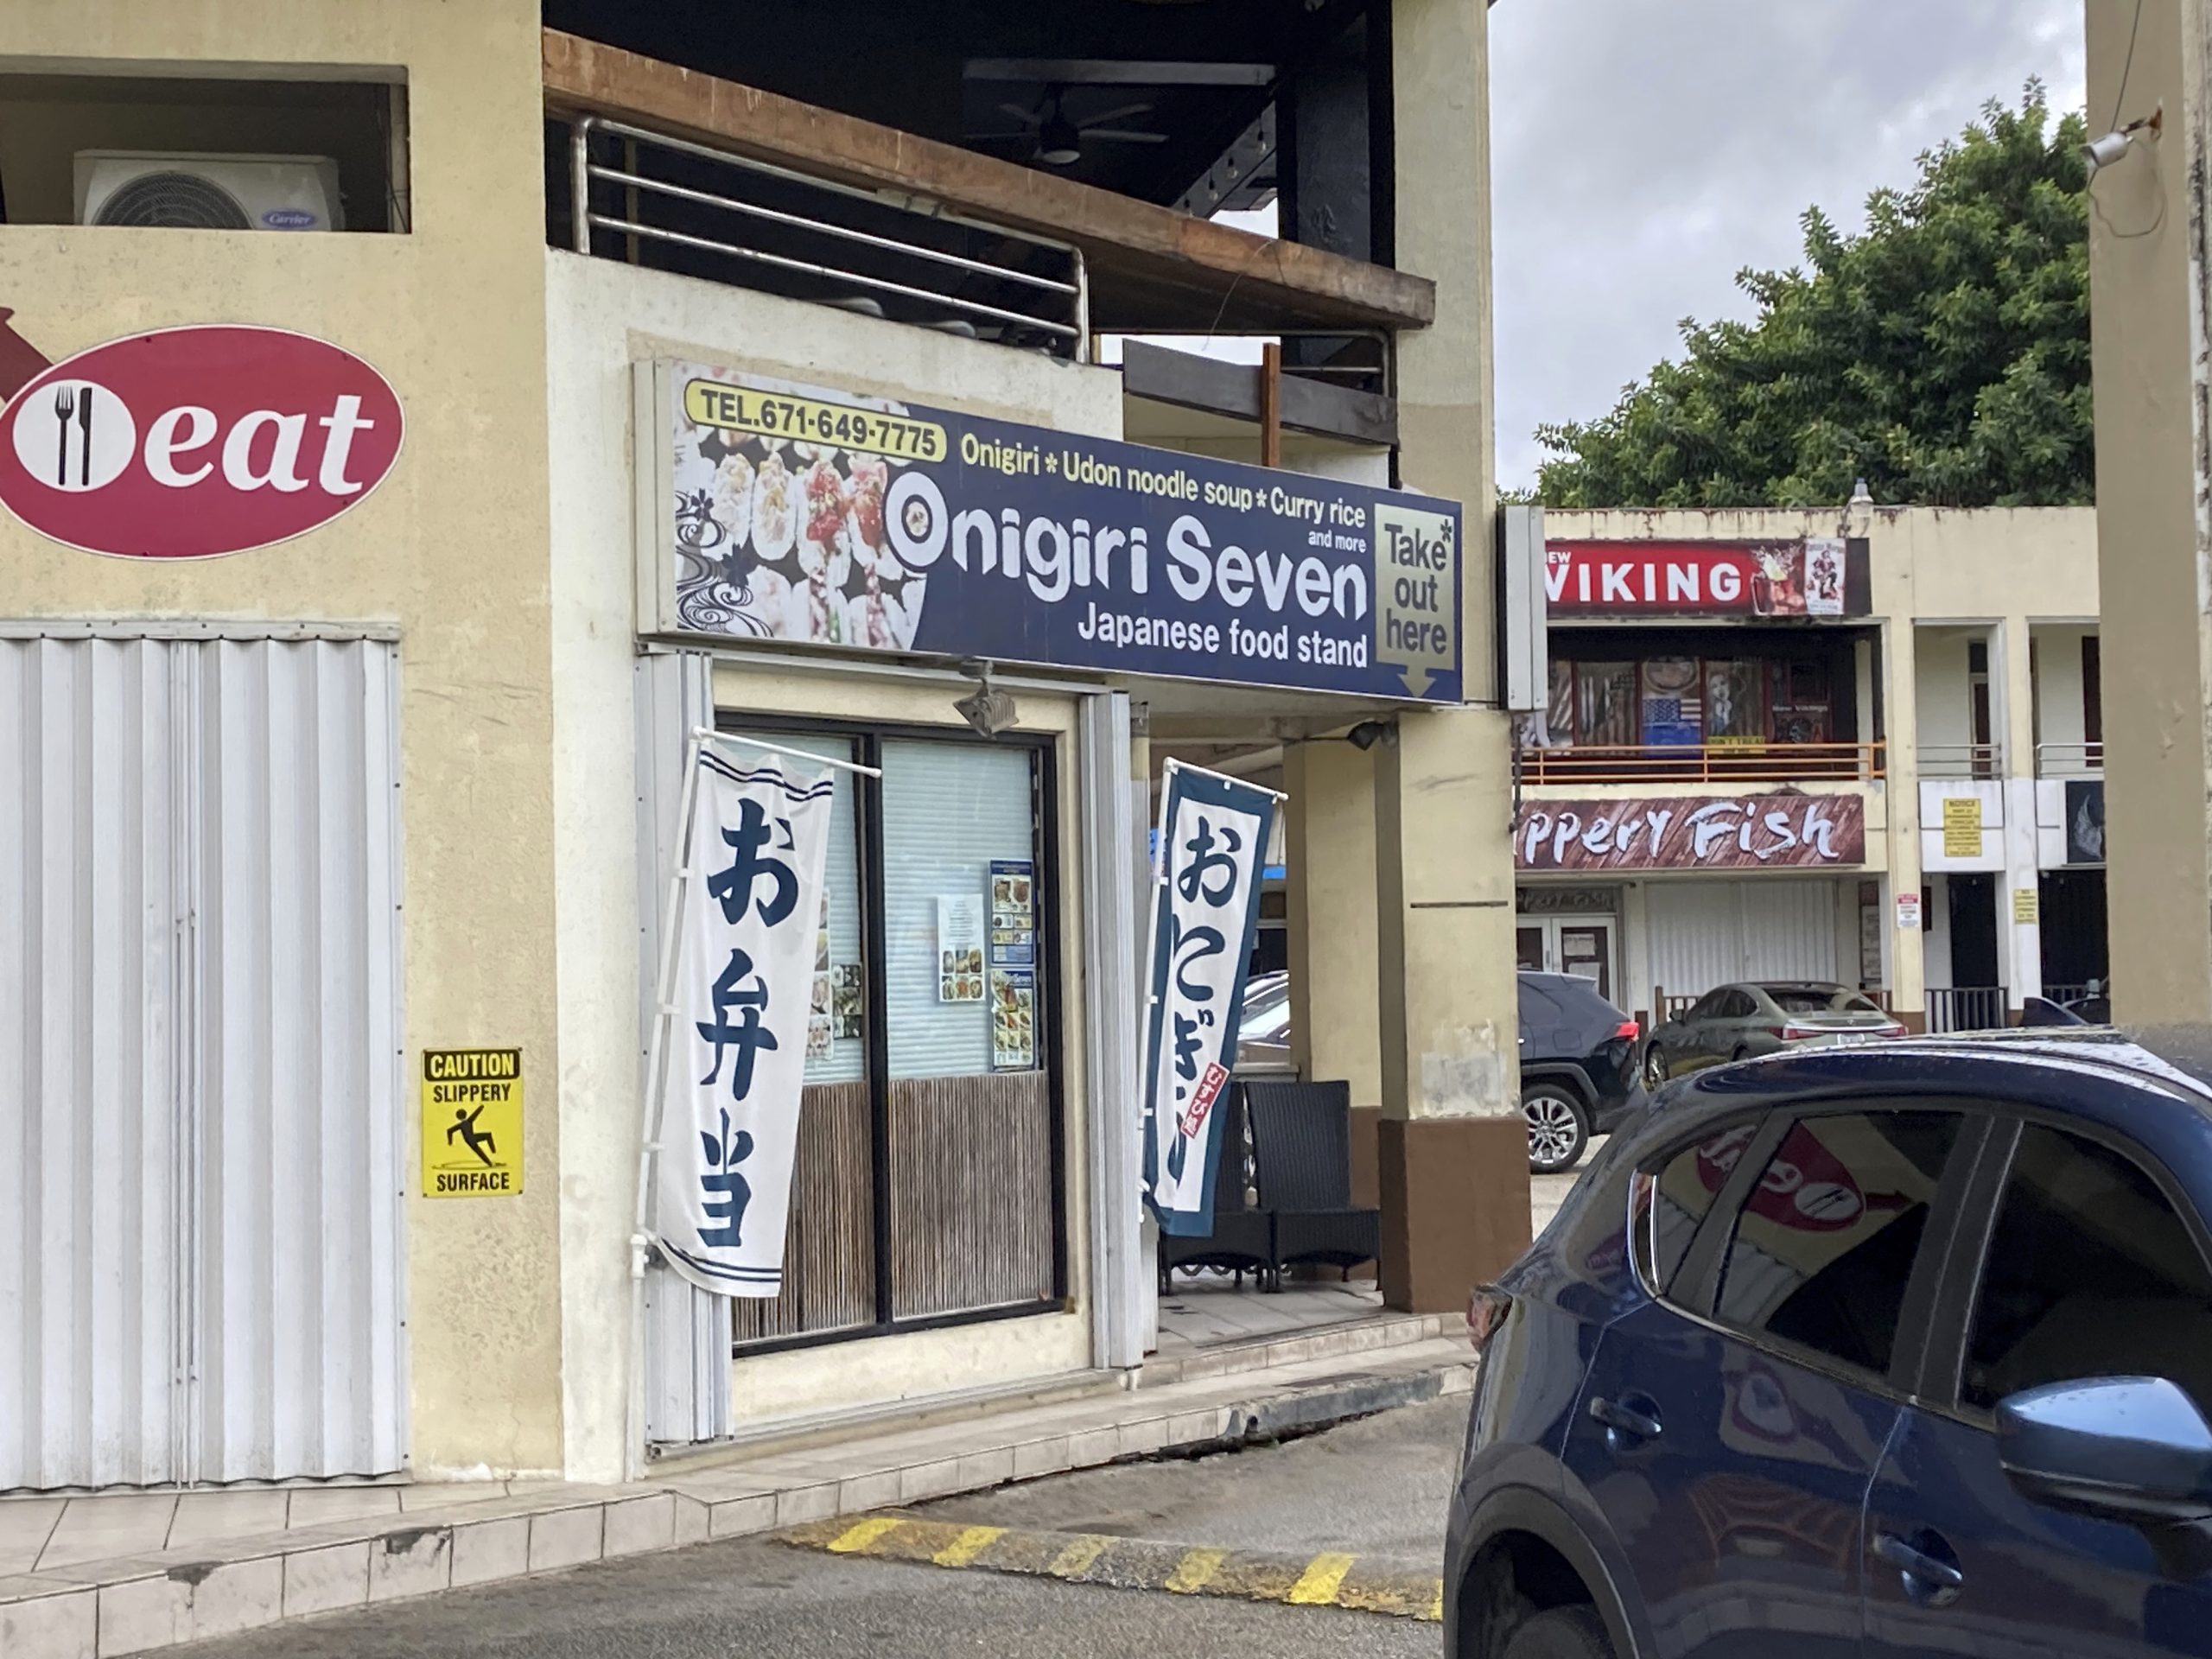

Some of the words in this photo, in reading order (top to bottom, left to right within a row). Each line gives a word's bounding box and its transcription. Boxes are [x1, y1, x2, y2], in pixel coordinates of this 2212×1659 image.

[269, 213, 311, 225] Carrier
[143, 394, 375, 495] eat
[701, 388, 938, 457] TEL.671-649-7775
[960, 433, 1039, 476] Onigiri
[1063, 450, 1121, 488] Udon
[1127, 468, 1198, 501] noodle
[1204, 481, 1253, 512] soup
[1270, 486, 1325, 525] Curry
[1329, 501, 1366, 530] rice
[886, 471, 1148, 603] Onigiri
[1166, 514, 1368, 621] Seven
[1308, 530, 1333, 549] and
[1335, 537, 1367, 553] more
[1384, 523, 1446, 571] Take
[1546, 551, 1573, 564] EW
[1395, 576, 1439, 613] out
[1545, 563, 1742, 602] VIKING
[1077, 602, 1220, 653] Japanese
[1229, 618, 1289, 660] food
[1297, 626, 1368, 669] stand
[1386, 609, 1447, 655] here
[1684, 801, 1840, 861] Fish
[696, 797, 800, 1249] お弁当
[430, 1052, 514, 1078] CAUTION
[433, 1083, 512, 1103] SLIPPERY
[436, 1172, 510, 1192] SURFACE
